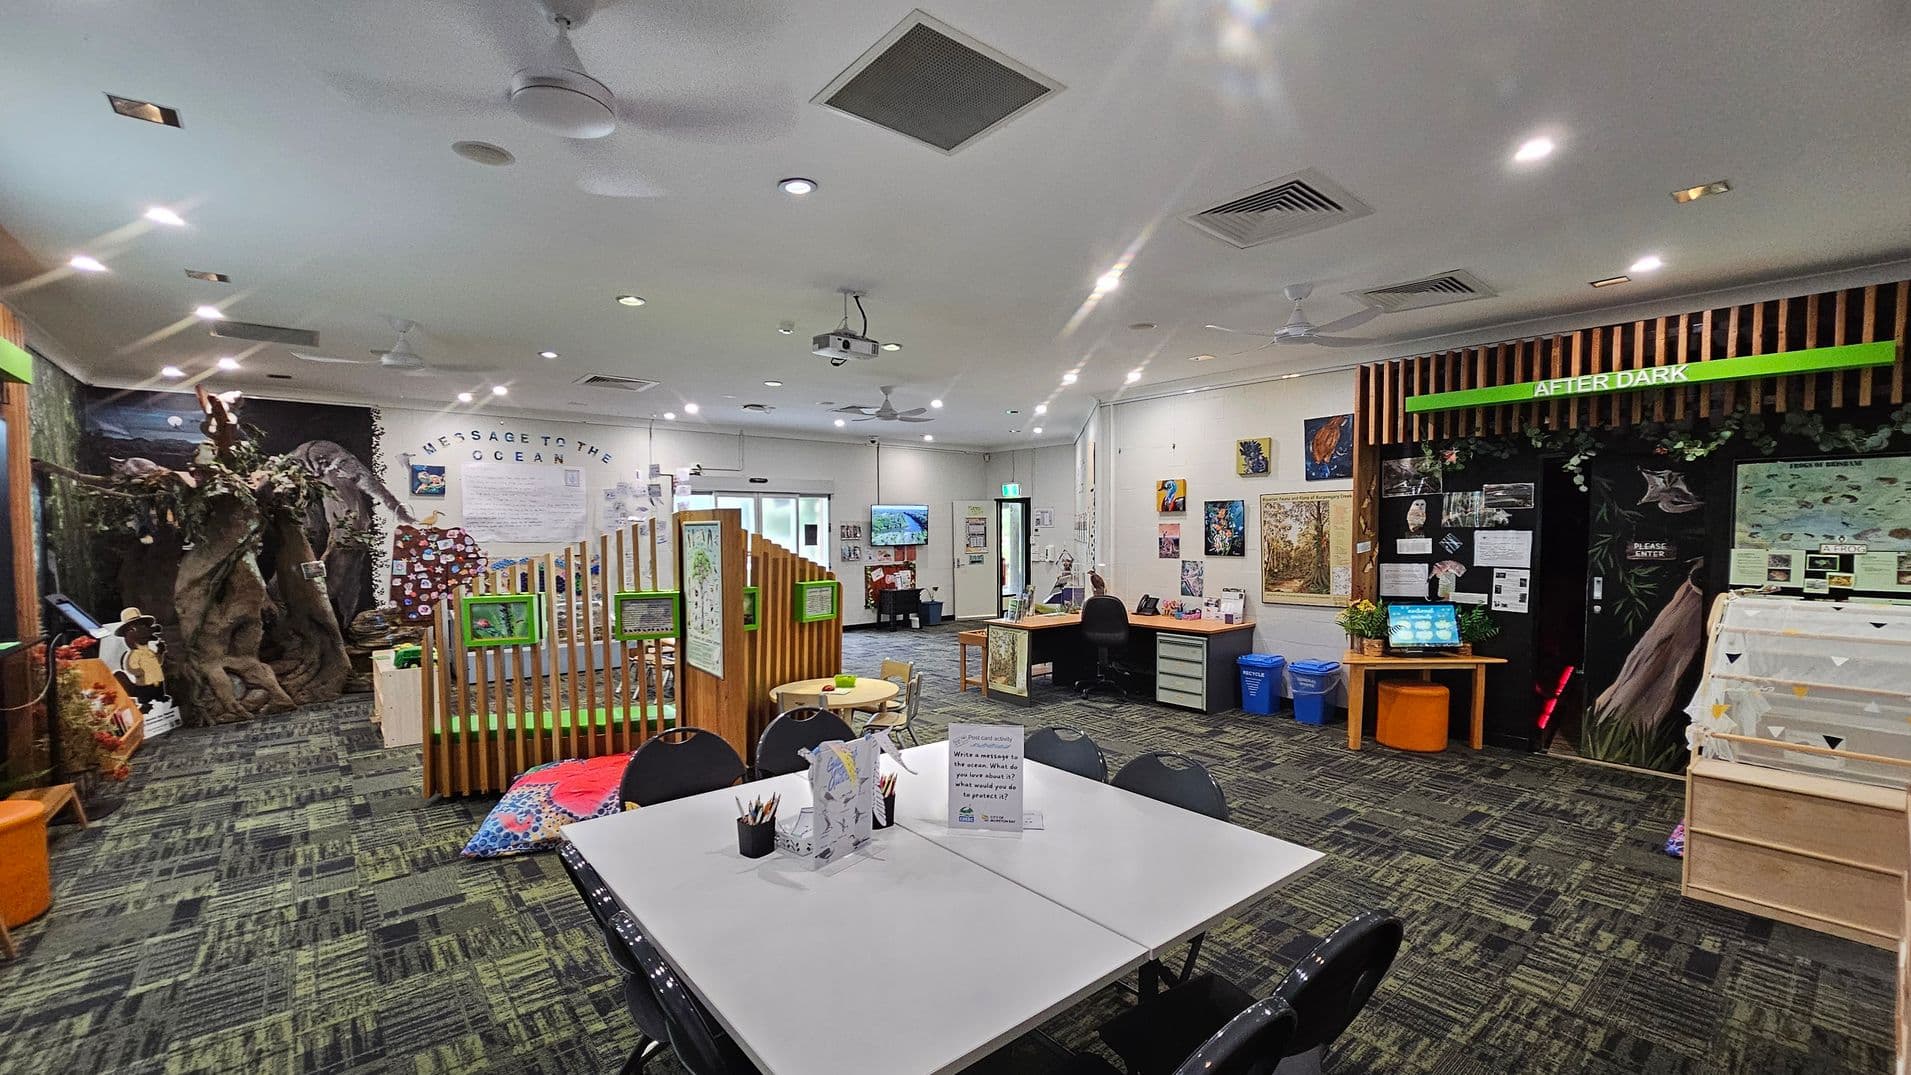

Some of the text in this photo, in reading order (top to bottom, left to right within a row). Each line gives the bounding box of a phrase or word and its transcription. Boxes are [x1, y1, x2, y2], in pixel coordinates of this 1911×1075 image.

[1534, 364, 1689, 397] AFTER DARK
[423, 430, 614, 465] MESSAGE TO THE
[472, 450, 565, 465] OCEAN
[1633, 542, 1668, 550] PLEASE
[1834, 545, 1866, 553] FROG
[1635, 550, 1666, 558] ENTER
[1242, 670, 1265, 678] RECYCLE
[980, 753, 1009, 761] message
